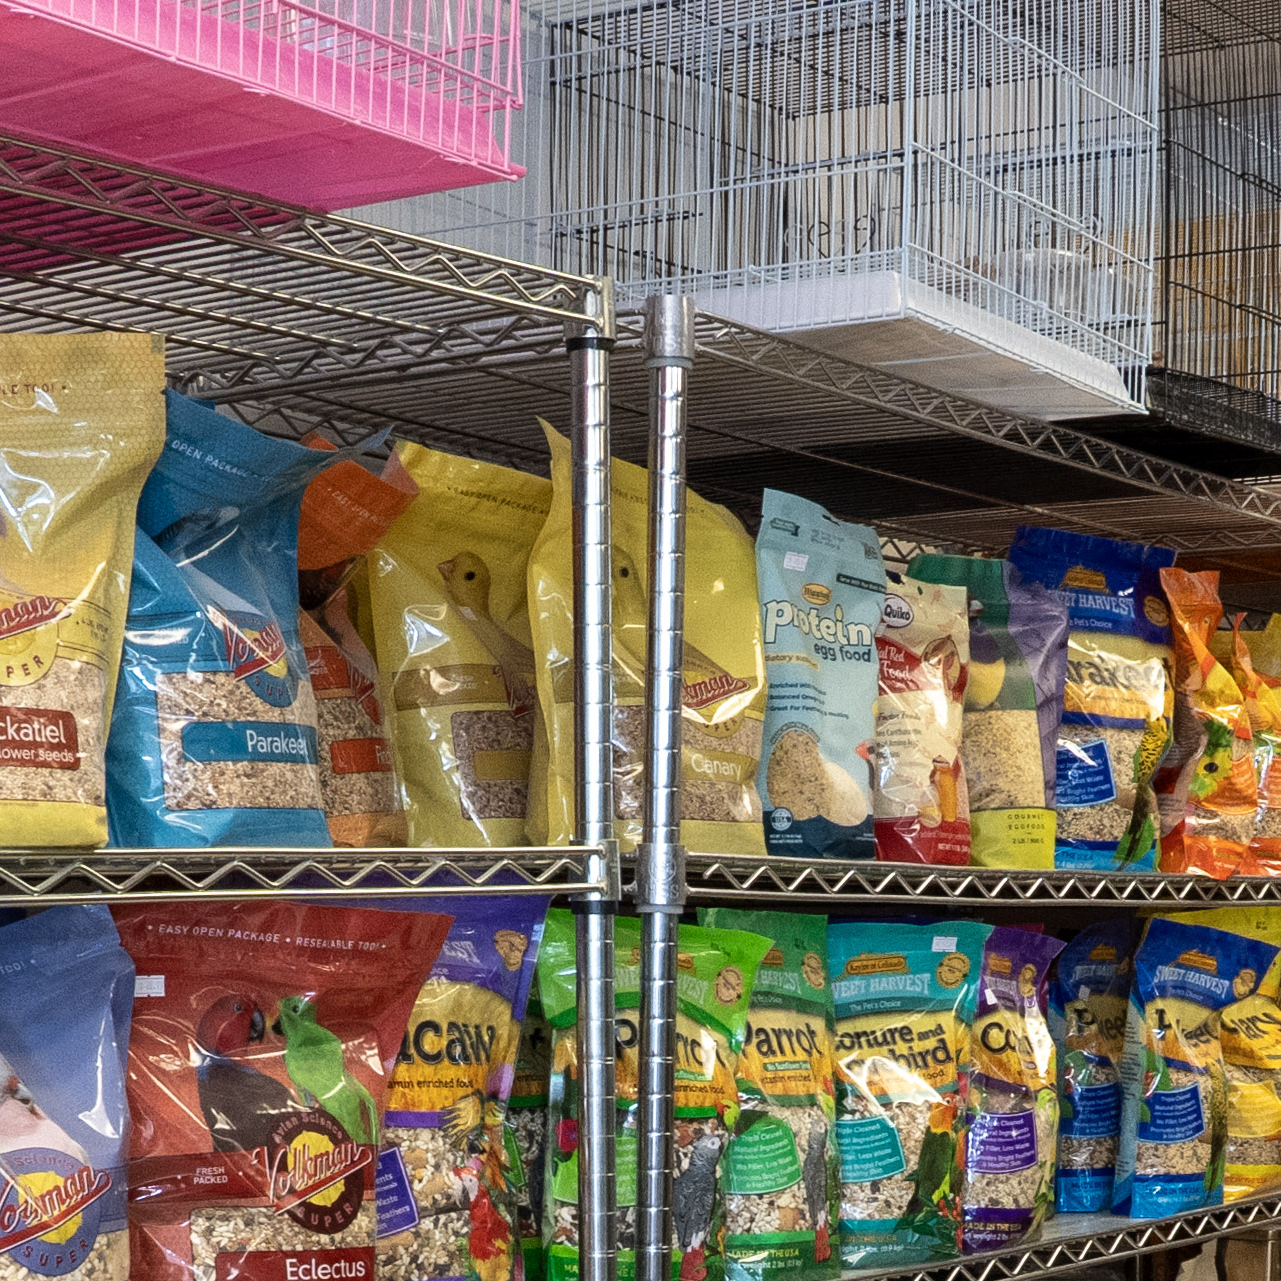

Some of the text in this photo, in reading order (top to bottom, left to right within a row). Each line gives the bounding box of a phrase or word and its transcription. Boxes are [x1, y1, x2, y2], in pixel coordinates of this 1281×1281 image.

[171, 439, 202, 464] OPEN
[1079, 593, 1136, 619] HARVEST
[814, 642, 872, 663] egg food
[38, 748, 75, 764] seeds
[690, 753, 743, 780] Canary
[158, 923, 380, 951] EASY OPEN PACKAGE RESEALABLE TOO!
[873, 973, 931, 996] HARVEST
[1153, 965, 1230, 999] SWEET HARVEST
[849, 999, 903, 1012] The Pet's Choice
[916, 1023, 946, 1042] and
[416, 1078, 455, 1090] enriched
[193, 1174, 229, 1186] PACKED
[195, 1166, 225, 1177] FRESH
[23, 1239, 88, 1269] SUPER
[285, 1258, 366, 1281] Eclectus
